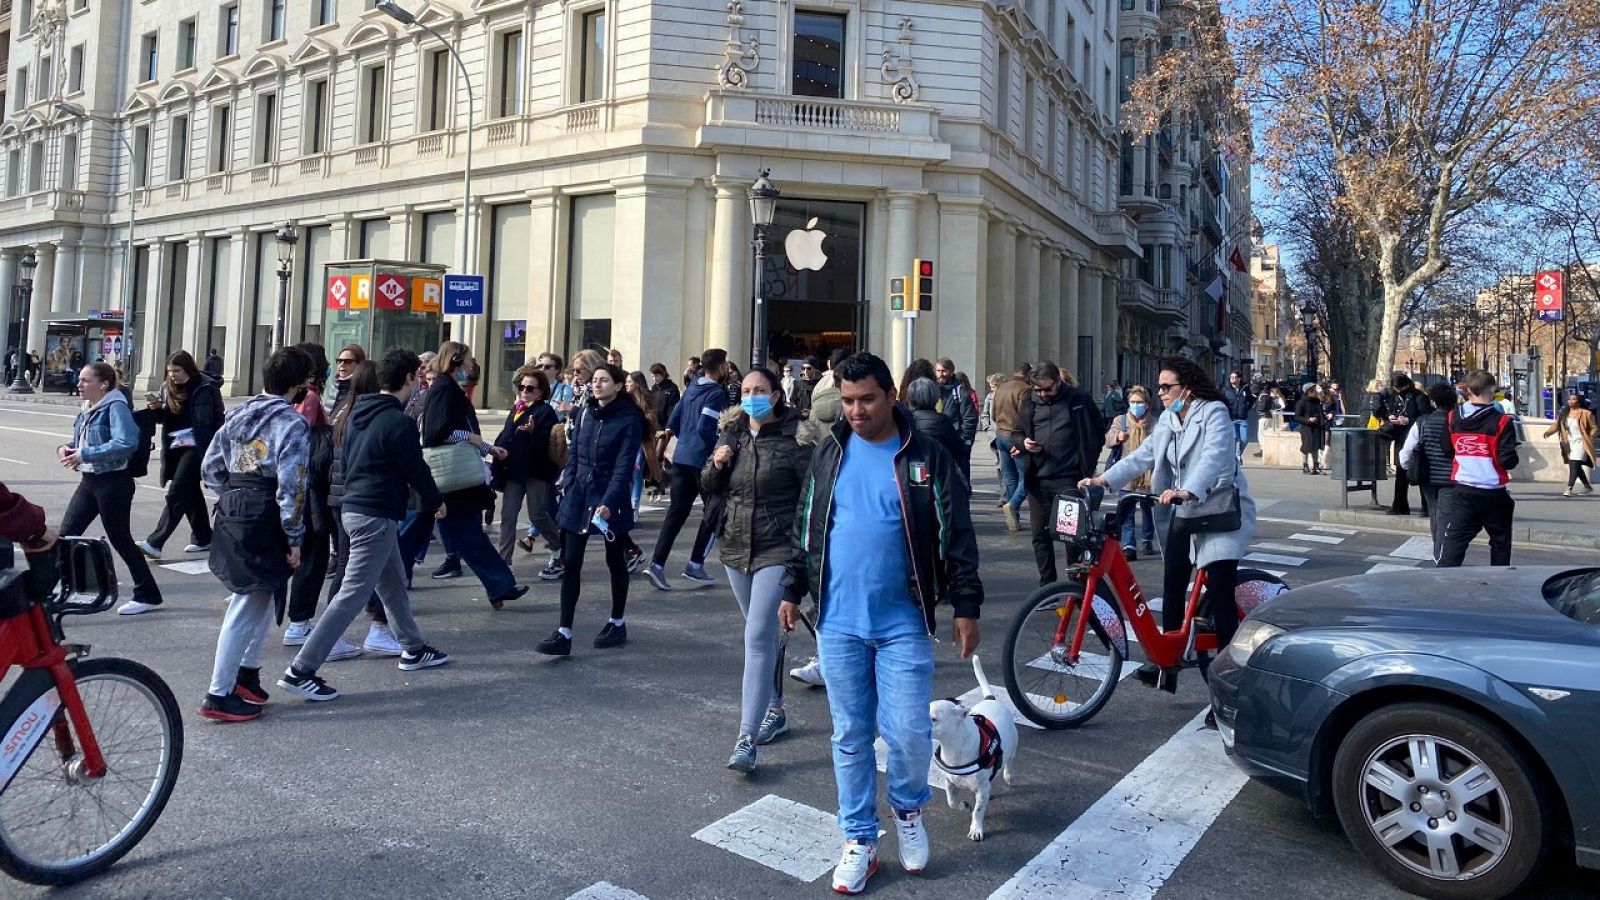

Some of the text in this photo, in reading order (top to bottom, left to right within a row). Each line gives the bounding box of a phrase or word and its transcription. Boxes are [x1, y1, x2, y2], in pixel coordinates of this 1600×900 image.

[358, 279, 369, 300] R
[385, 283, 397, 295] M
[423, 283, 440, 304] R
[456, 298, 472, 307] taxi
